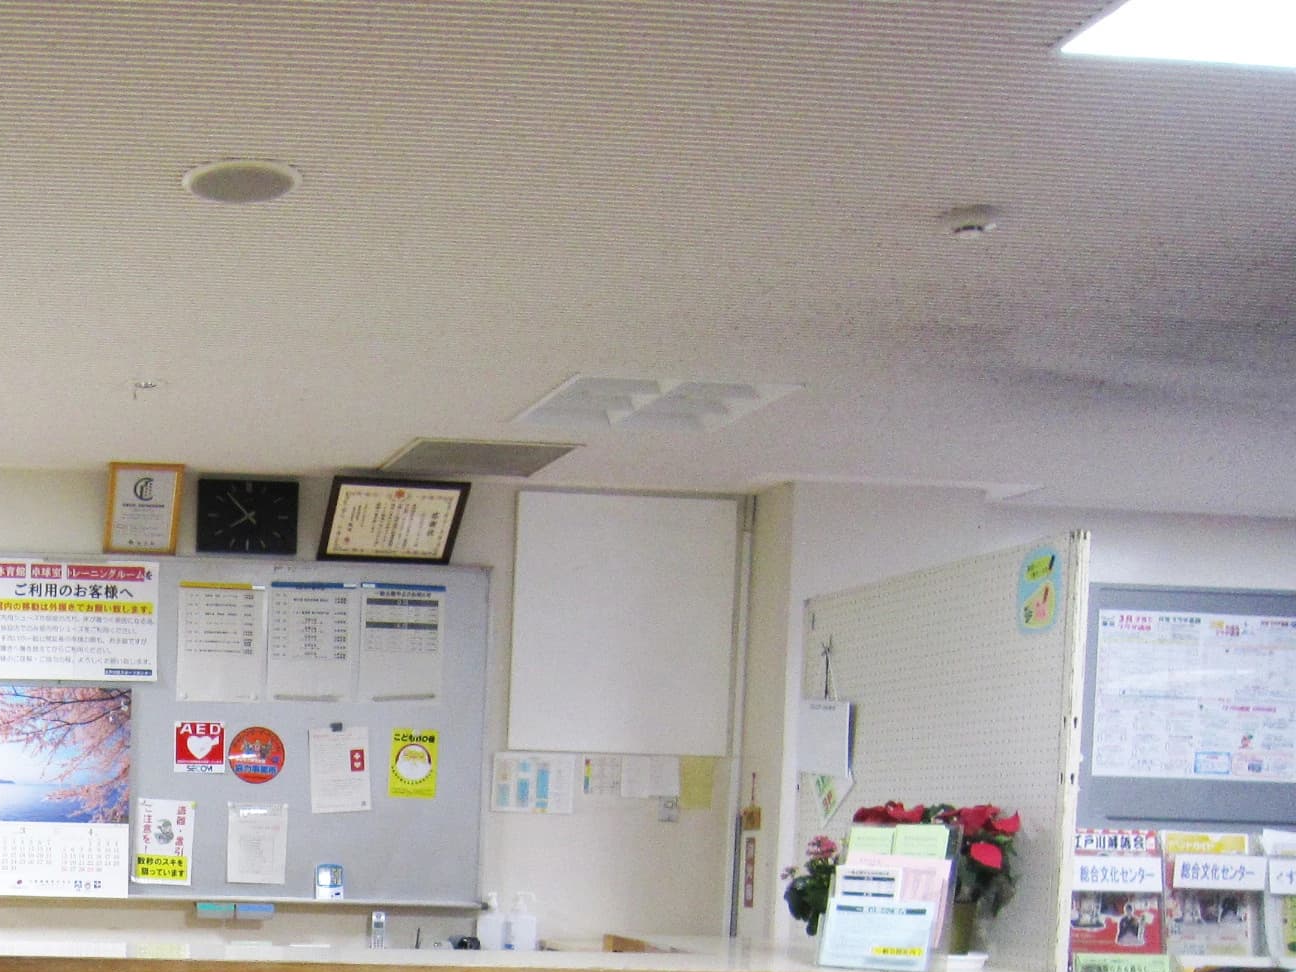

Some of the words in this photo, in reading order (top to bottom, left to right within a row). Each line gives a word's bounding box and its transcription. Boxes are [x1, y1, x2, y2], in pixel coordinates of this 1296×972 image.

[14, 583, 134, 599] ご利用のお客様へ
[180, 723, 221, 735] AED
[1079, 864, 1154, 884] 総合文化センター
[1180, 861, 1255, 880] 総合文化センター
